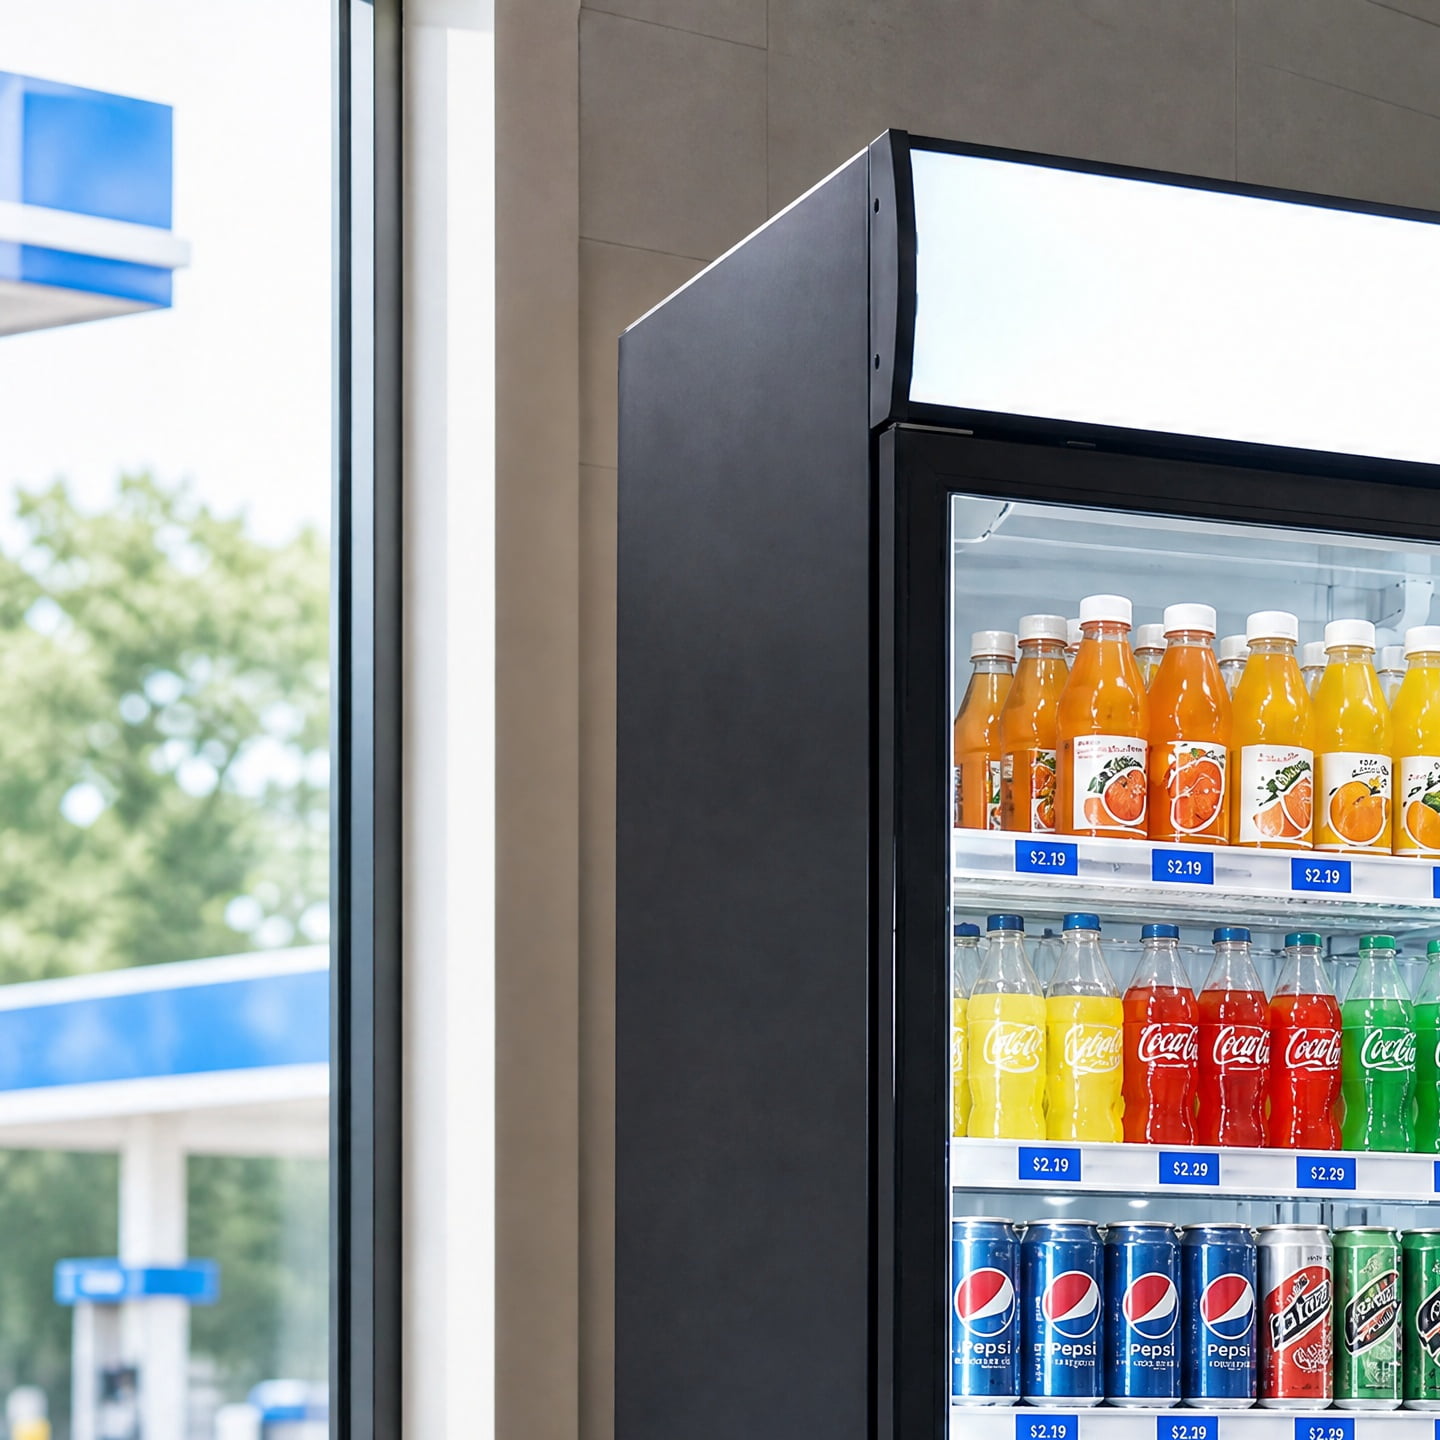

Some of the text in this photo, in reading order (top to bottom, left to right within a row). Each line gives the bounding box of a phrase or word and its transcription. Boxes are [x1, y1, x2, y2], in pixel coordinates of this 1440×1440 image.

[1167, 859, 1202, 876] $2.19
[1173, 1161, 1208, 1177] $2.29
[1310, 1166, 1345, 1181] $2.29
[962, 1340, 1011, 1357] Pepsi
[1051, 1341, 1097, 1359] Pepsi
[1130, 1342, 1175, 1359] Pepsi
[1208, 1343, 1250, 1360] Pepsi
